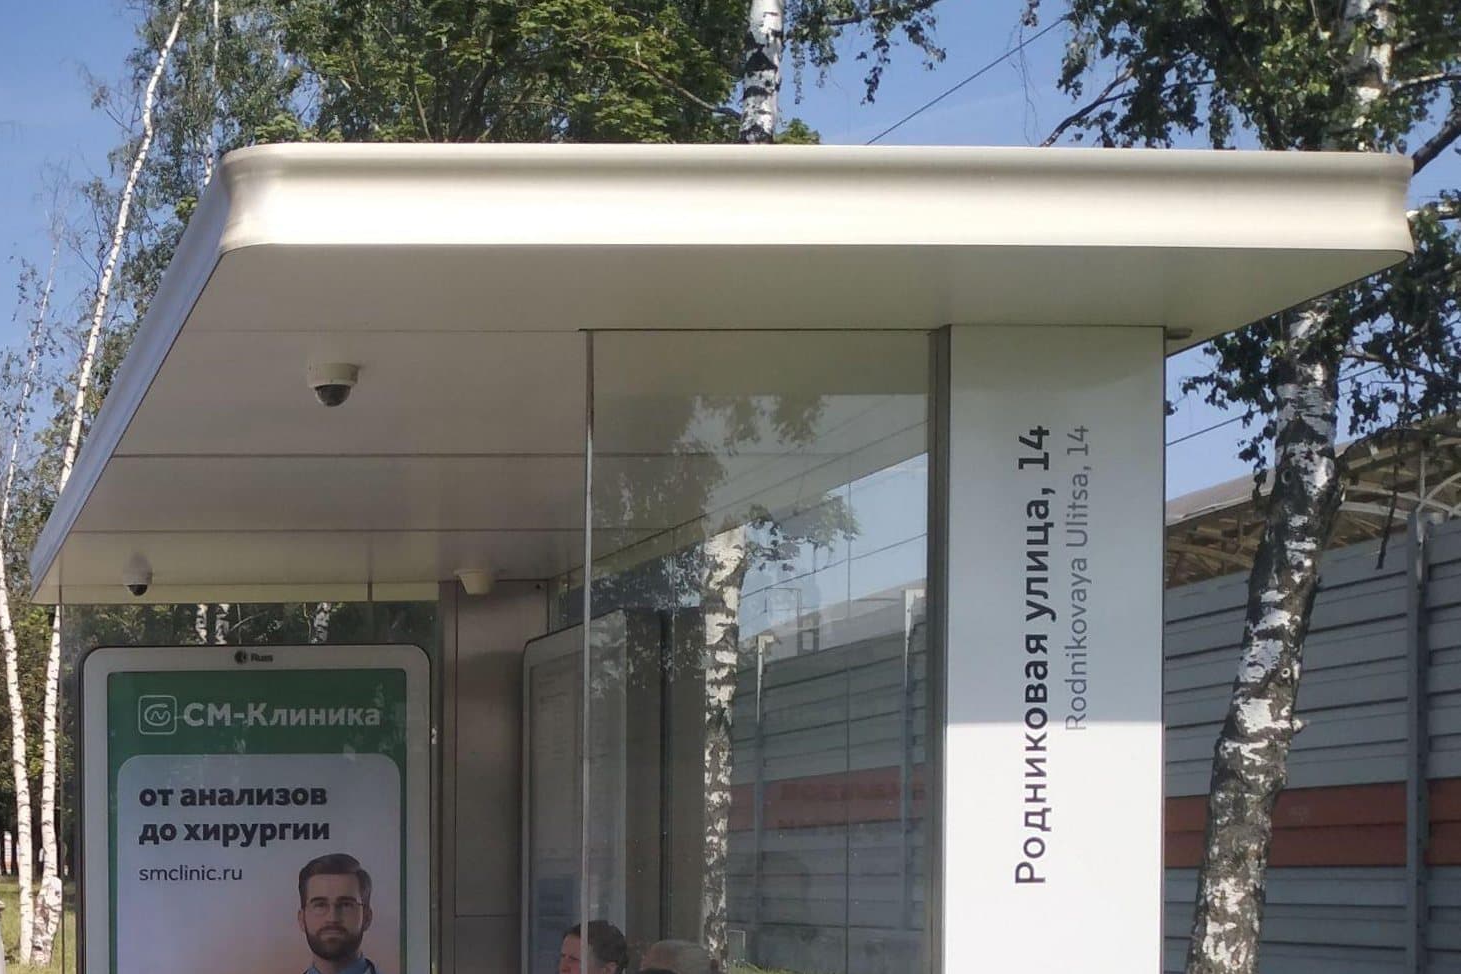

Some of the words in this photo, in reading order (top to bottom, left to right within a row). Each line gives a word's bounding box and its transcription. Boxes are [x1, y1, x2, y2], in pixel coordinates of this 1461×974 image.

[1018, 425, 1050, 470] 14
[1066, 425, 1089, 456] 14
[1065, 465, 1092, 548] Ulitsa,
[1025, 487, 1057, 622] улица,
[1065, 557, 1092, 731] Rodnikovaya
[183, 702, 382, 727] СМ-Клиника
[1014, 634, 1052, 884] Родниковая
[139, 787, 174, 807] от
[179, 787, 328, 807] анализов
[138, 822, 177, 845] до
[183, 822, 330, 847] хирургии
[139, 864, 243, 881] smclinic.ru
